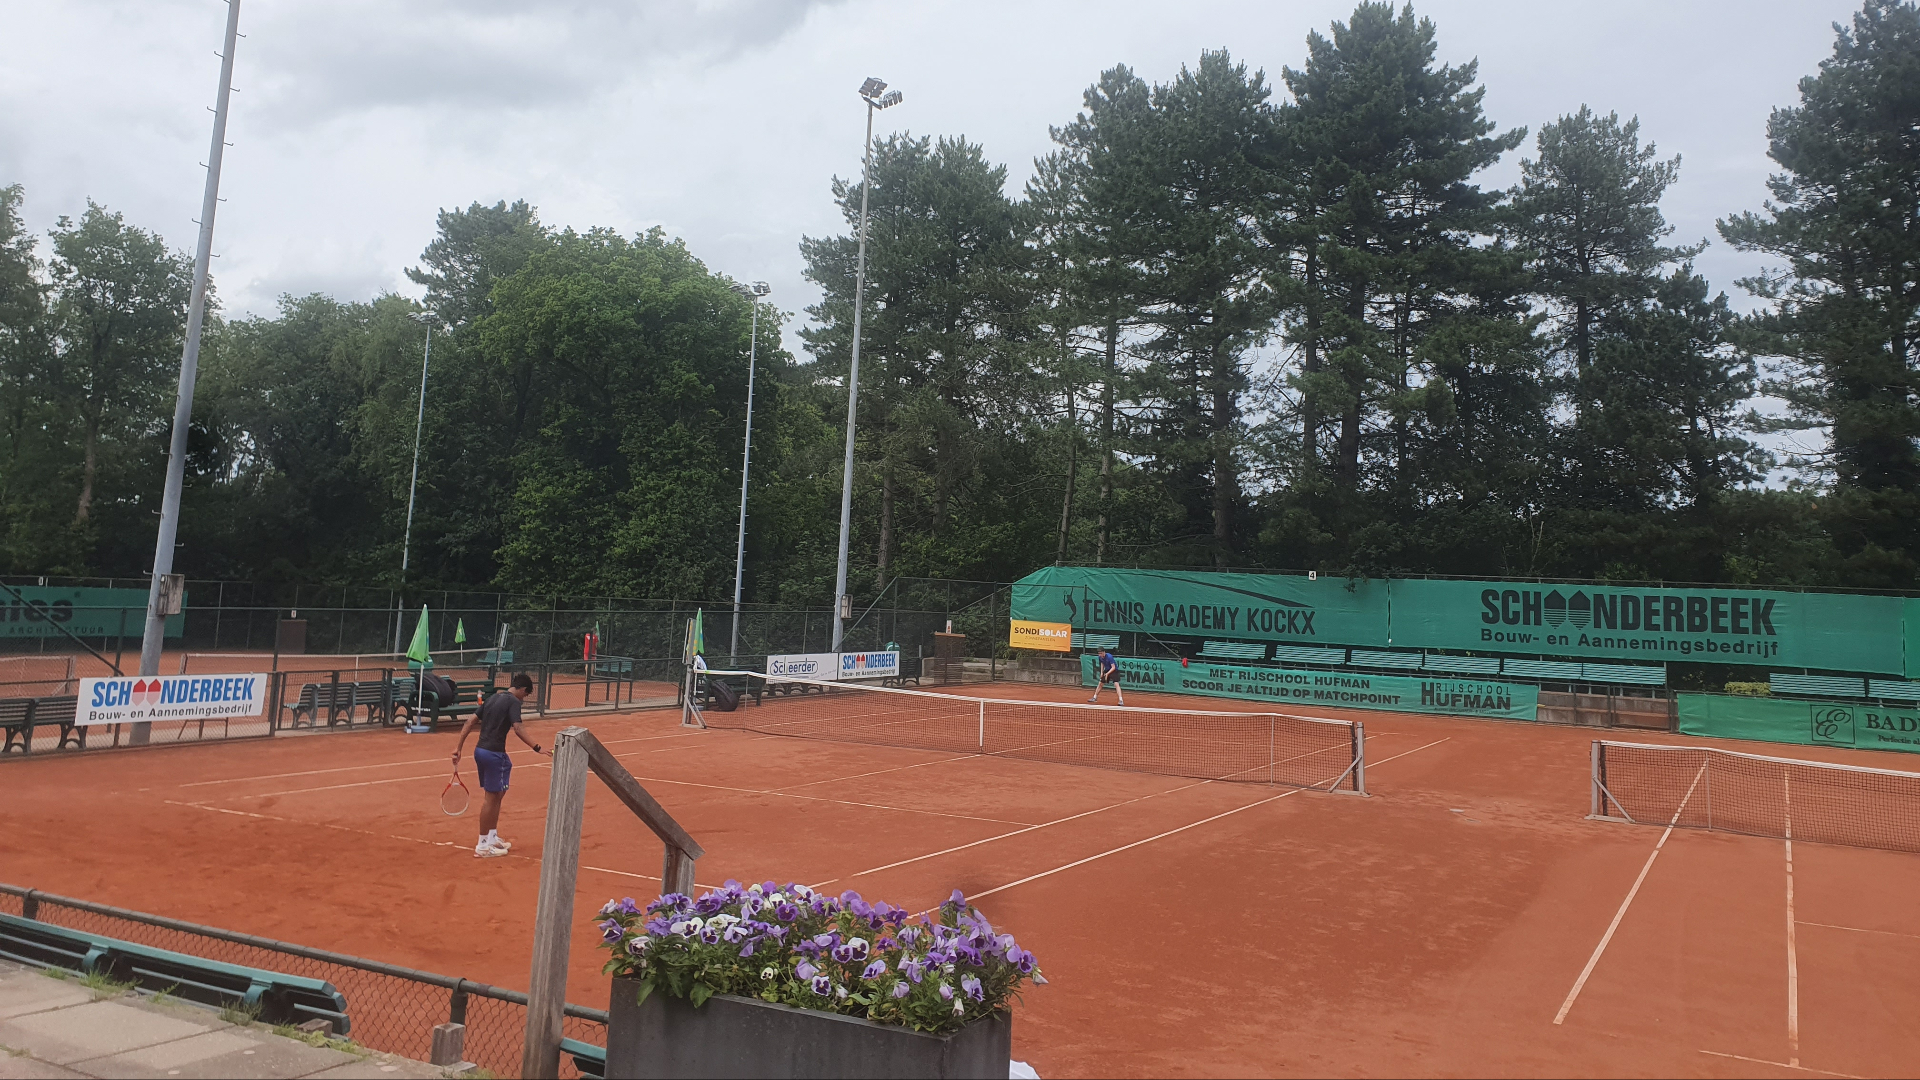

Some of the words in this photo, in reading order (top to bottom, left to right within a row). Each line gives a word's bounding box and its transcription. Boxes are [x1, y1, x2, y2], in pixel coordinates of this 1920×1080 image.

[0, 588, 73, 623] ies
[1083, 599, 1144, 625] TENNIS
[1152, 602, 1239, 631] ACADEMY
[1247, 607, 1316, 635] KOCKX
[1014, 627, 1068, 638] SONDISOLAR
[1481, 628, 1539, 643] Bouw-
[1546, 634, 1569, 645] en
[1578, 633, 1778, 658] Aannemingsbedrijf
[1092, 658, 1164, 686] HFMAN
[1117, 660, 1164, 672] JSCHOOL
[1209, 668, 1234, 679] MET
[1238, 670, 1311, 685] RIJSCHOOL
[1314, 675, 1370, 689] HUFMAN
[1436, 682, 1511, 696] RIJSCHOOL
[1182, 679, 1224, 692] SCOOR
[1227, 683, 1242, 693] JE
[1245, 684, 1289, 698] ALTIJD
[1292, 688, 1311, 699] OP
[1313, 689, 1401, 705] MATCHPOINT
[1421, 681, 1511, 711] HUFMAN
[89, 709, 126, 721] Bouw-
[130, 709, 144, 718] en
[149, 703, 252, 718] Aannemingsbedrijf
[1865, 713, 1920, 733] BAD
